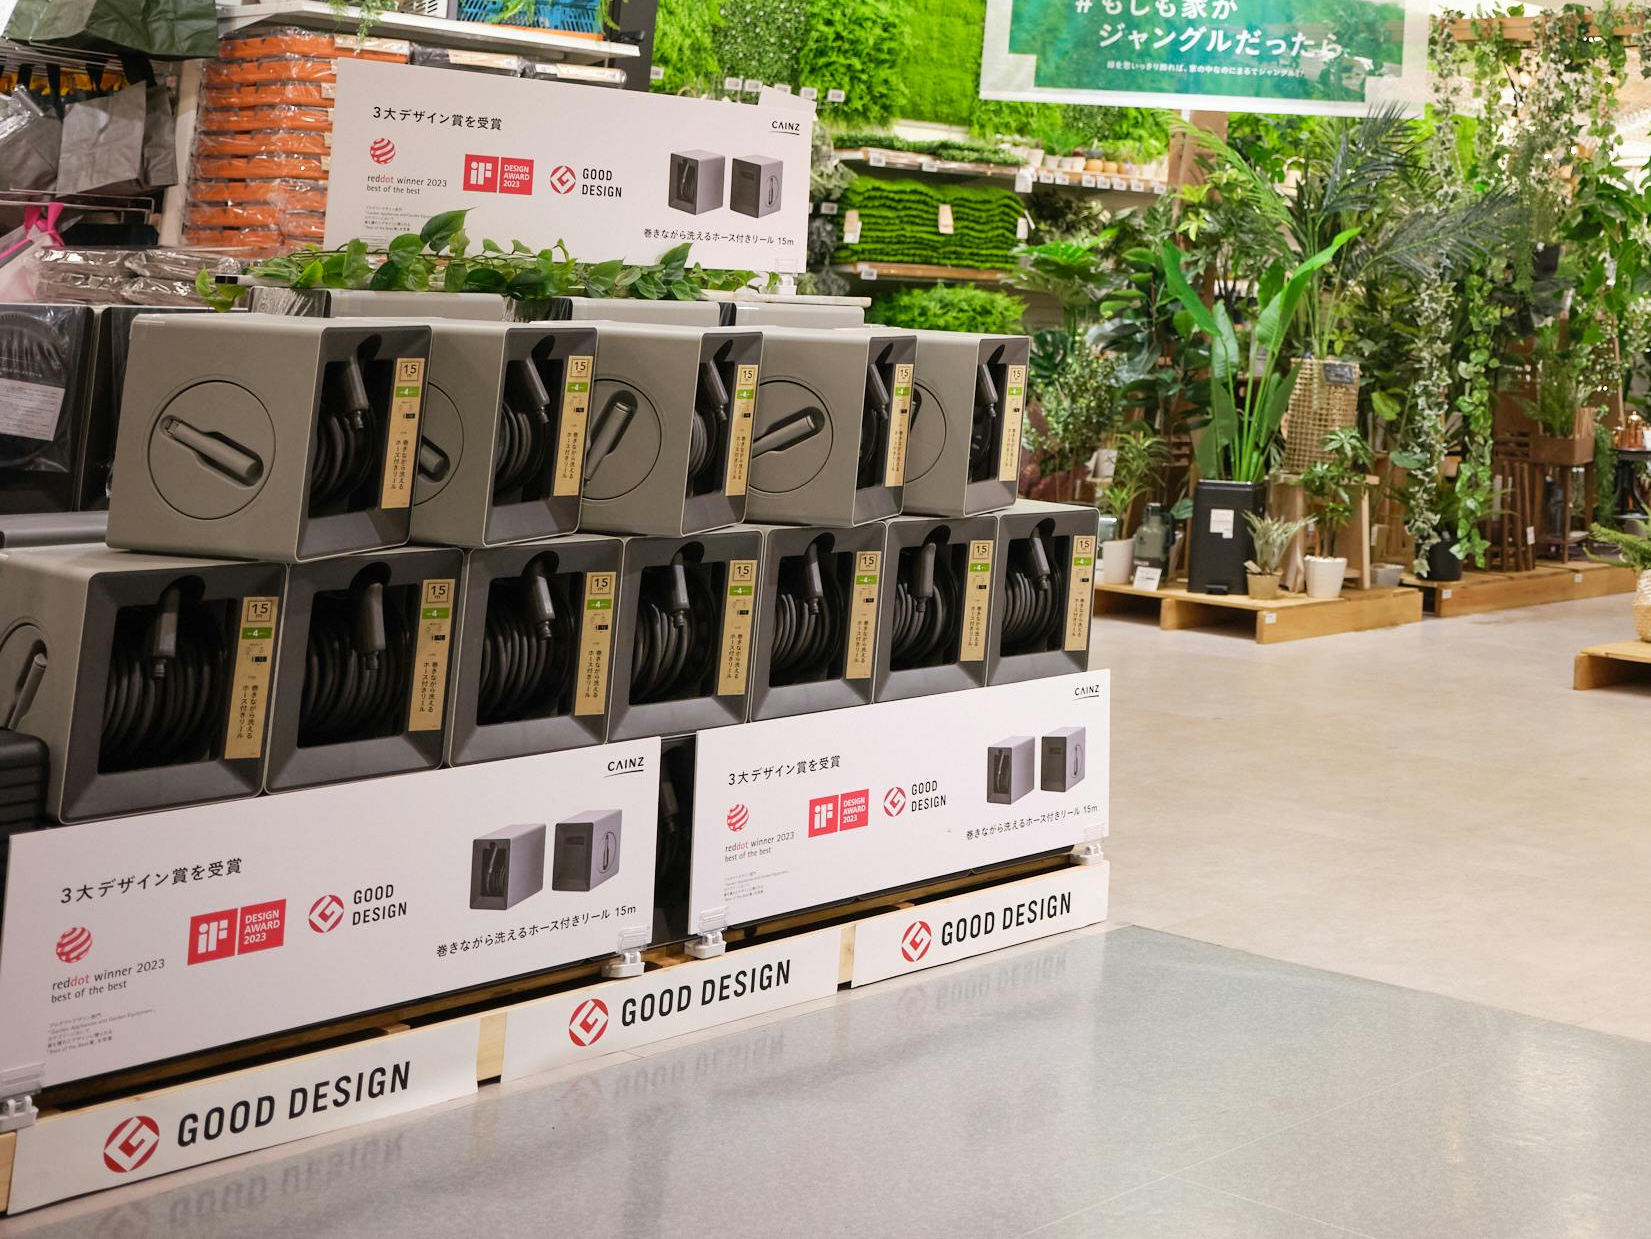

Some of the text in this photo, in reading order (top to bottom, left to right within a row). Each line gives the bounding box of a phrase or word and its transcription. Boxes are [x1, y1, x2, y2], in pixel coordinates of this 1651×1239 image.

[1098, 22, 1343, 62] ジャングルだったら
[372, 106, 503, 131] 3大デザイン賞を受賞
[771, 120, 800, 132] CAINZ
[504, 164, 529, 174] DESIGN
[582, 168, 613, 181] GOOD
[503, 172, 530, 181] AWARD
[503, 180, 520, 188] 2023
[582, 184, 622, 198] DESIGN
[777, 236, 794, 246] 15m
[403, 364, 417, 374] 15
[573, 361, 587, 371] 15
[743, 370, 753, 379] 15
[976, 545, 987, 554] 15
[1079, 540, 1090, 548] 15
[863, 556, 875, 565] 15
[736, 566, 750, 575] 15
[594, 577, 608, 588] 15
[431, 585, 446, 596] 15
[252, 603, 268, 614] 15
[1074, 684, 1100, 696] CAINZ
[607, 756, 644, 772] CAINZ
[911, 780, 938, 796] GOOD
[843, 796, 866, 808] DESIGN
[911, 794, 947, 812] DESIGN
[843, 804, 866, 816] AWARD
[842, 814, 858, 824] 2023
[60, 857, 242, 904] 3大デザイン賞を受賞
[352, 883, 395, 906] GOOD
[245, 909, 280, 924] DESIGN
[351, 899, 408, 927] DESIGN
[615, 905, 637, 918] 15m
[941, 891, 1073, 947] GOOD DESIGN
[244, 920, 281, 935] AWARD
[243, 933, 267, 945] 2023
[52, 958, 165, 991] reddot winner 2023
[51, 980, 127, 1003] best of the best
[621, 959, 792, 1028] GOOD DESIGN
[177, 1061, 411, 1148] GOOD DESIGN
